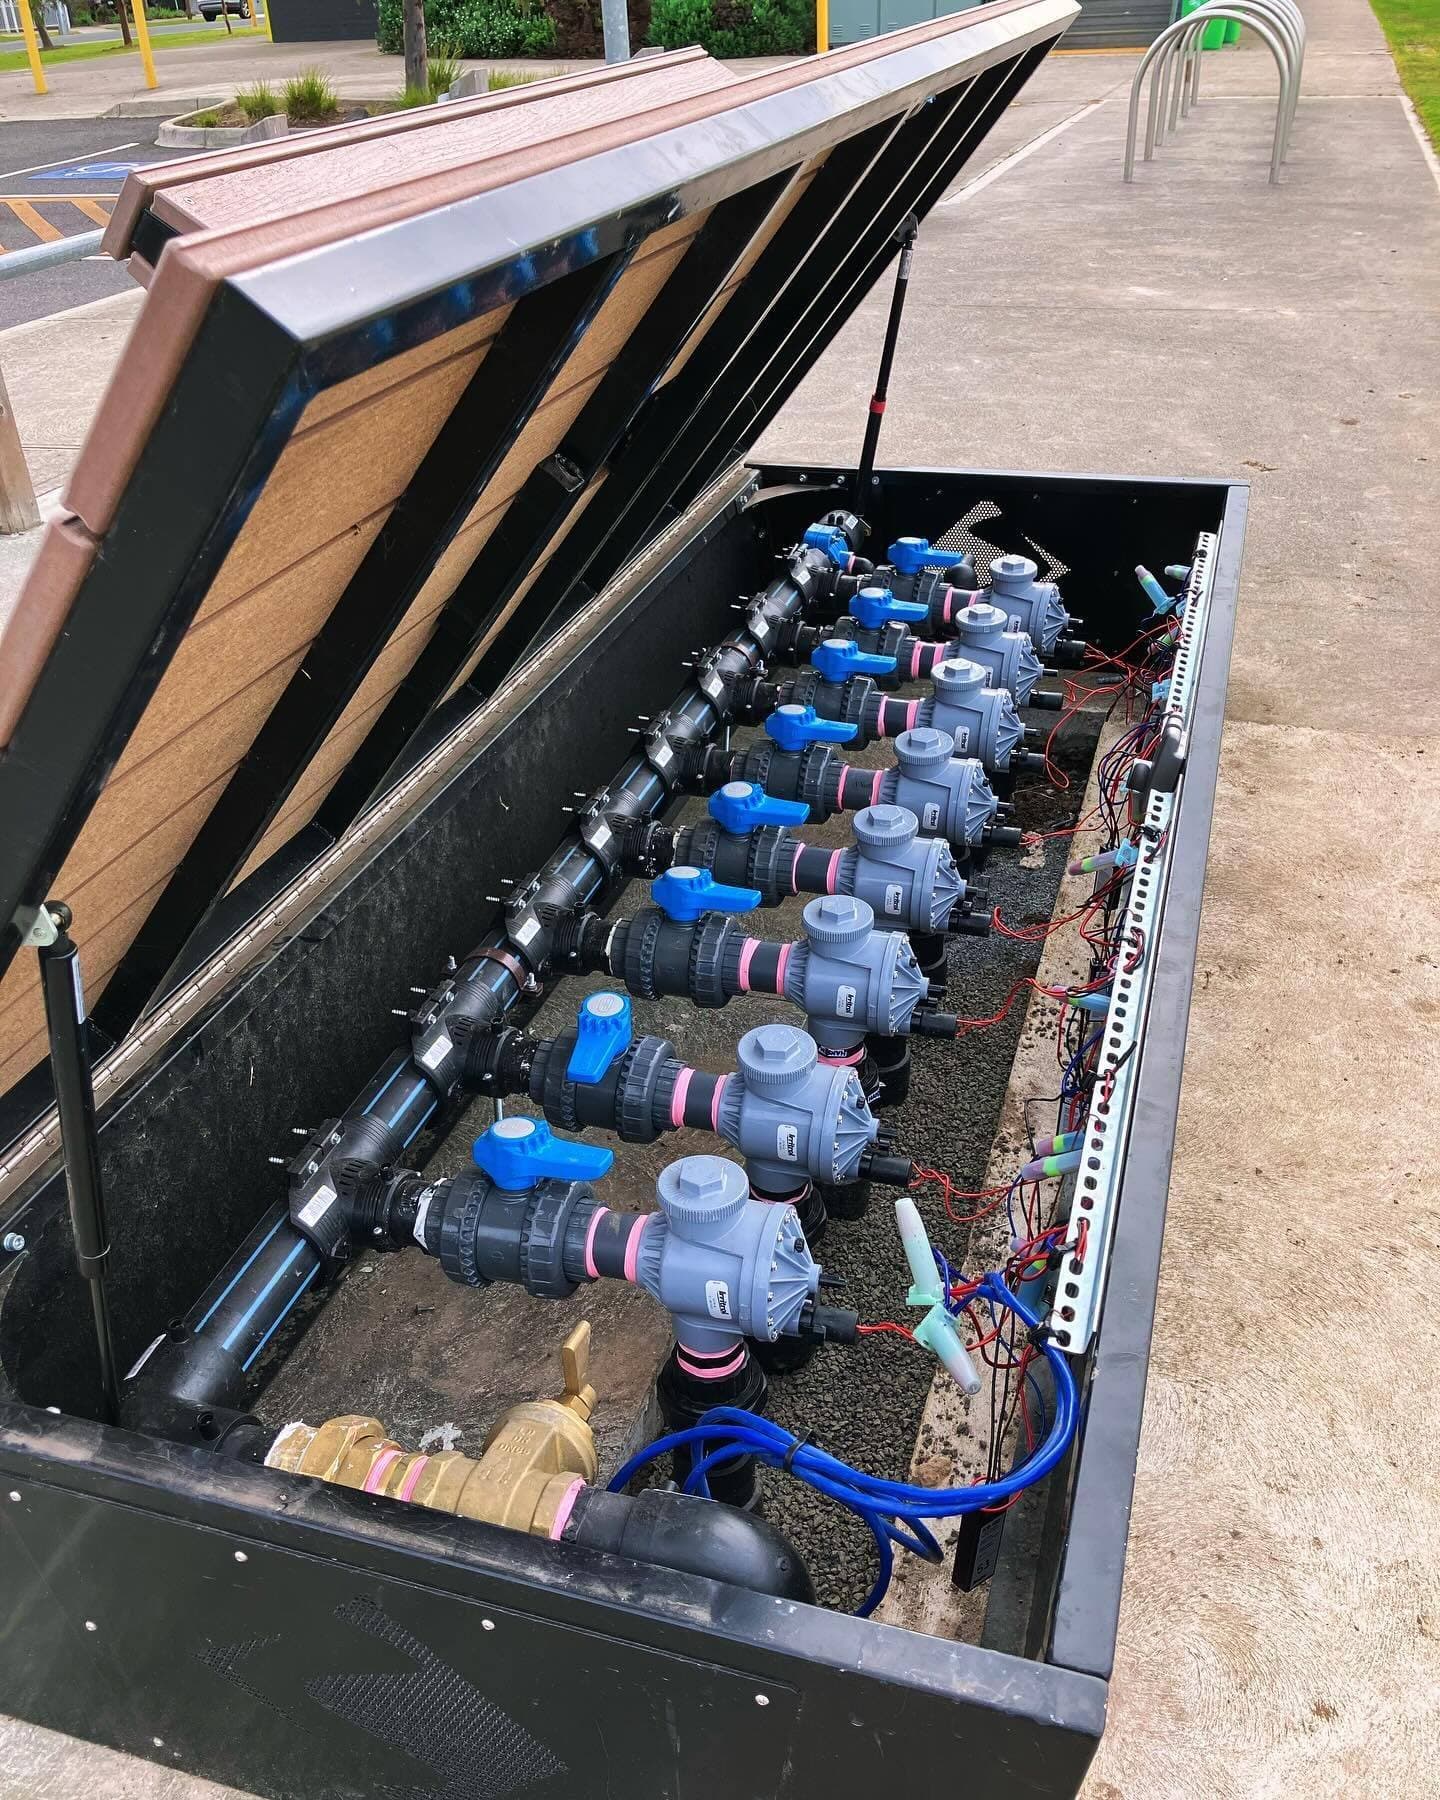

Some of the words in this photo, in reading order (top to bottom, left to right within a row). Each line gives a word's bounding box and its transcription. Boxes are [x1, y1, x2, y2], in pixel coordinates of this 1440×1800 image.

[845, 993, 855, 1014] Irritrol
[787, 1133, 796, 1157] Irritrol
[717, 1290, 730, 1316] Irritrol
